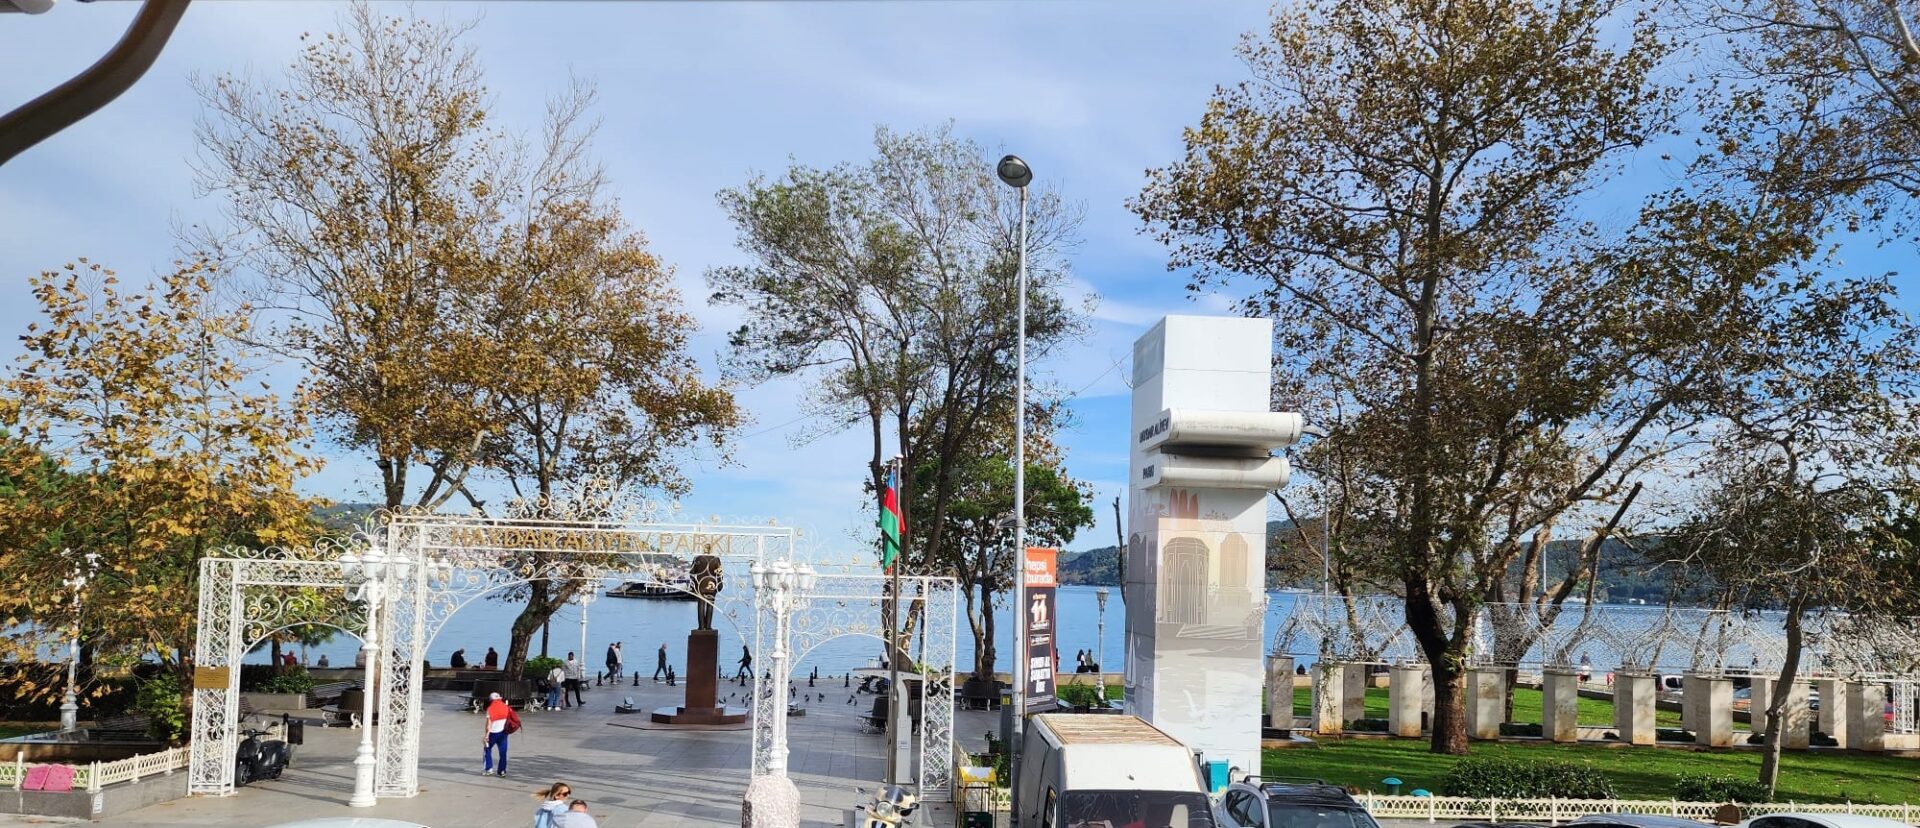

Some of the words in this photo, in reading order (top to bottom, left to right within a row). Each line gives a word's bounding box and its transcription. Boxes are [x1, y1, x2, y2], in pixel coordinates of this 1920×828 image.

[450, 527, 558, 550] HAYDAR
[658, 532, 732, 554] PARKI
[1026, 560, 1047, 573] hepsi
[1026, 572, 1053, 584] burada
